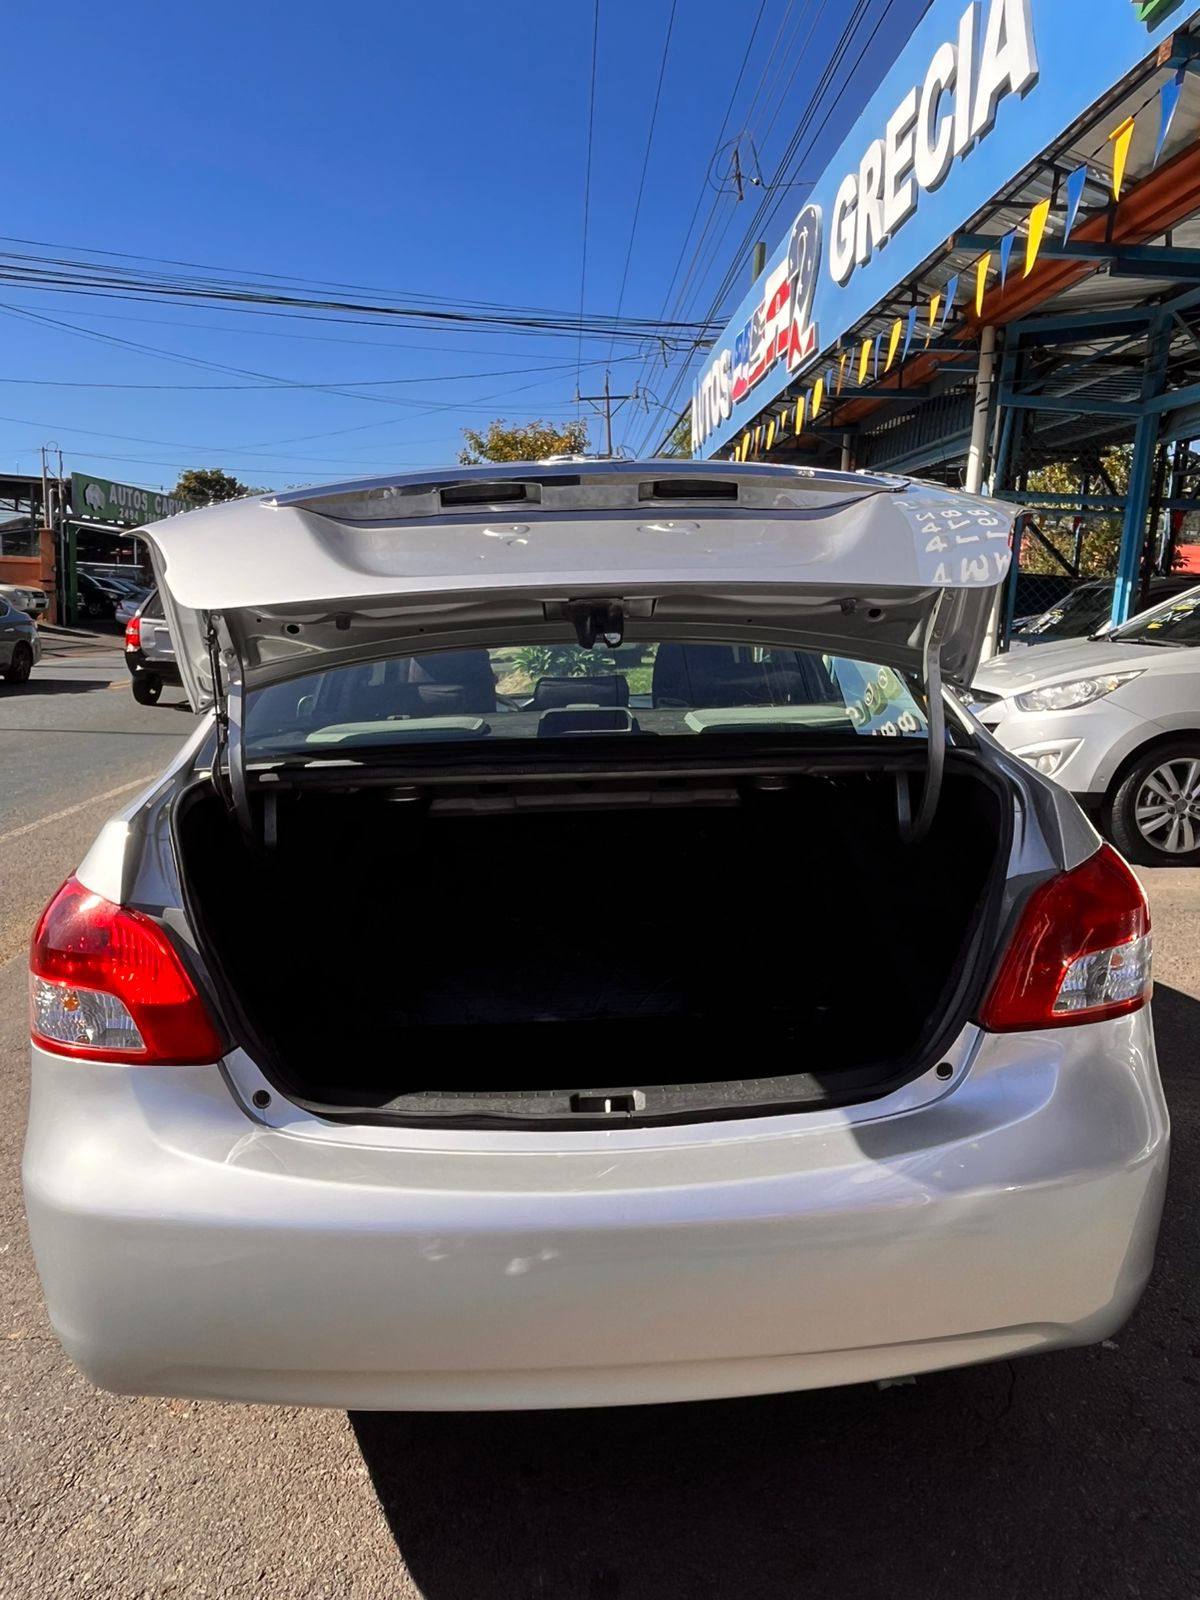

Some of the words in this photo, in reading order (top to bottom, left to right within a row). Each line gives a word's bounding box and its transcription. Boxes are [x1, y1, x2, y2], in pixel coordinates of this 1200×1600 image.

[691, 349, 734, 452] AUTOS
[829, 0, 1038, 284] GRECIA
[109, 484, 148, 512] AUTOS
